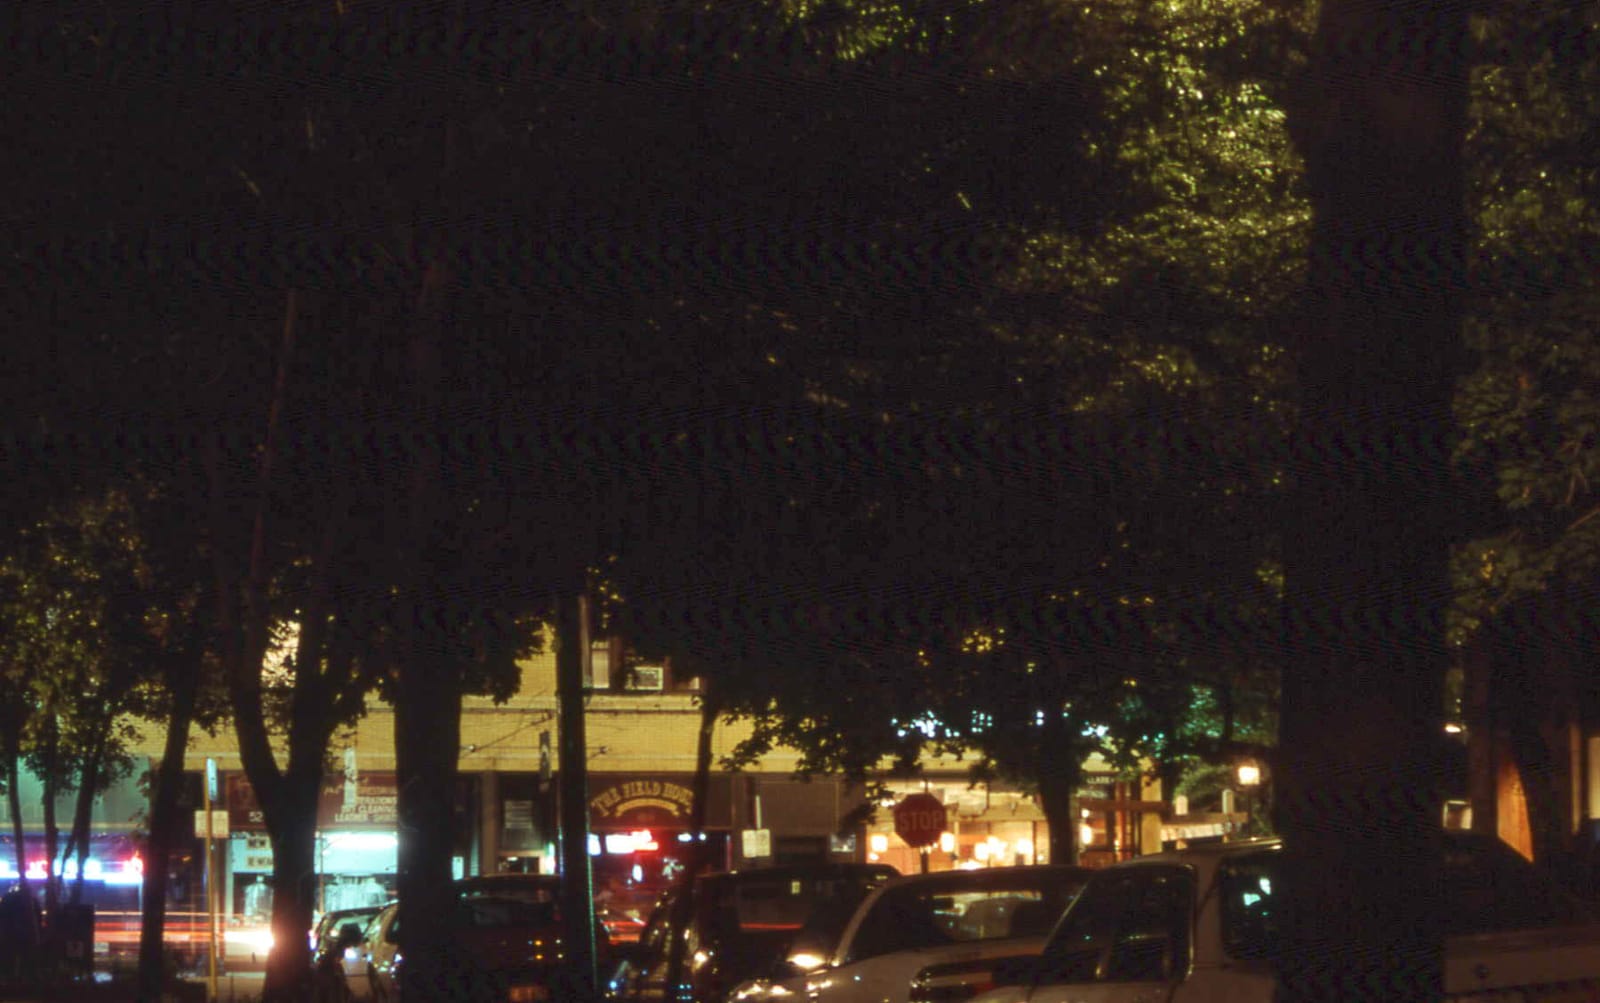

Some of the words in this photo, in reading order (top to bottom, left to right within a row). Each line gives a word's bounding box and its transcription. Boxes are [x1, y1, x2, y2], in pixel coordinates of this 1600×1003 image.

[590, 787, 621, 817] THE
[622, 781, 661, 798] FIELD
[898, 810, 943, 832] STOP
